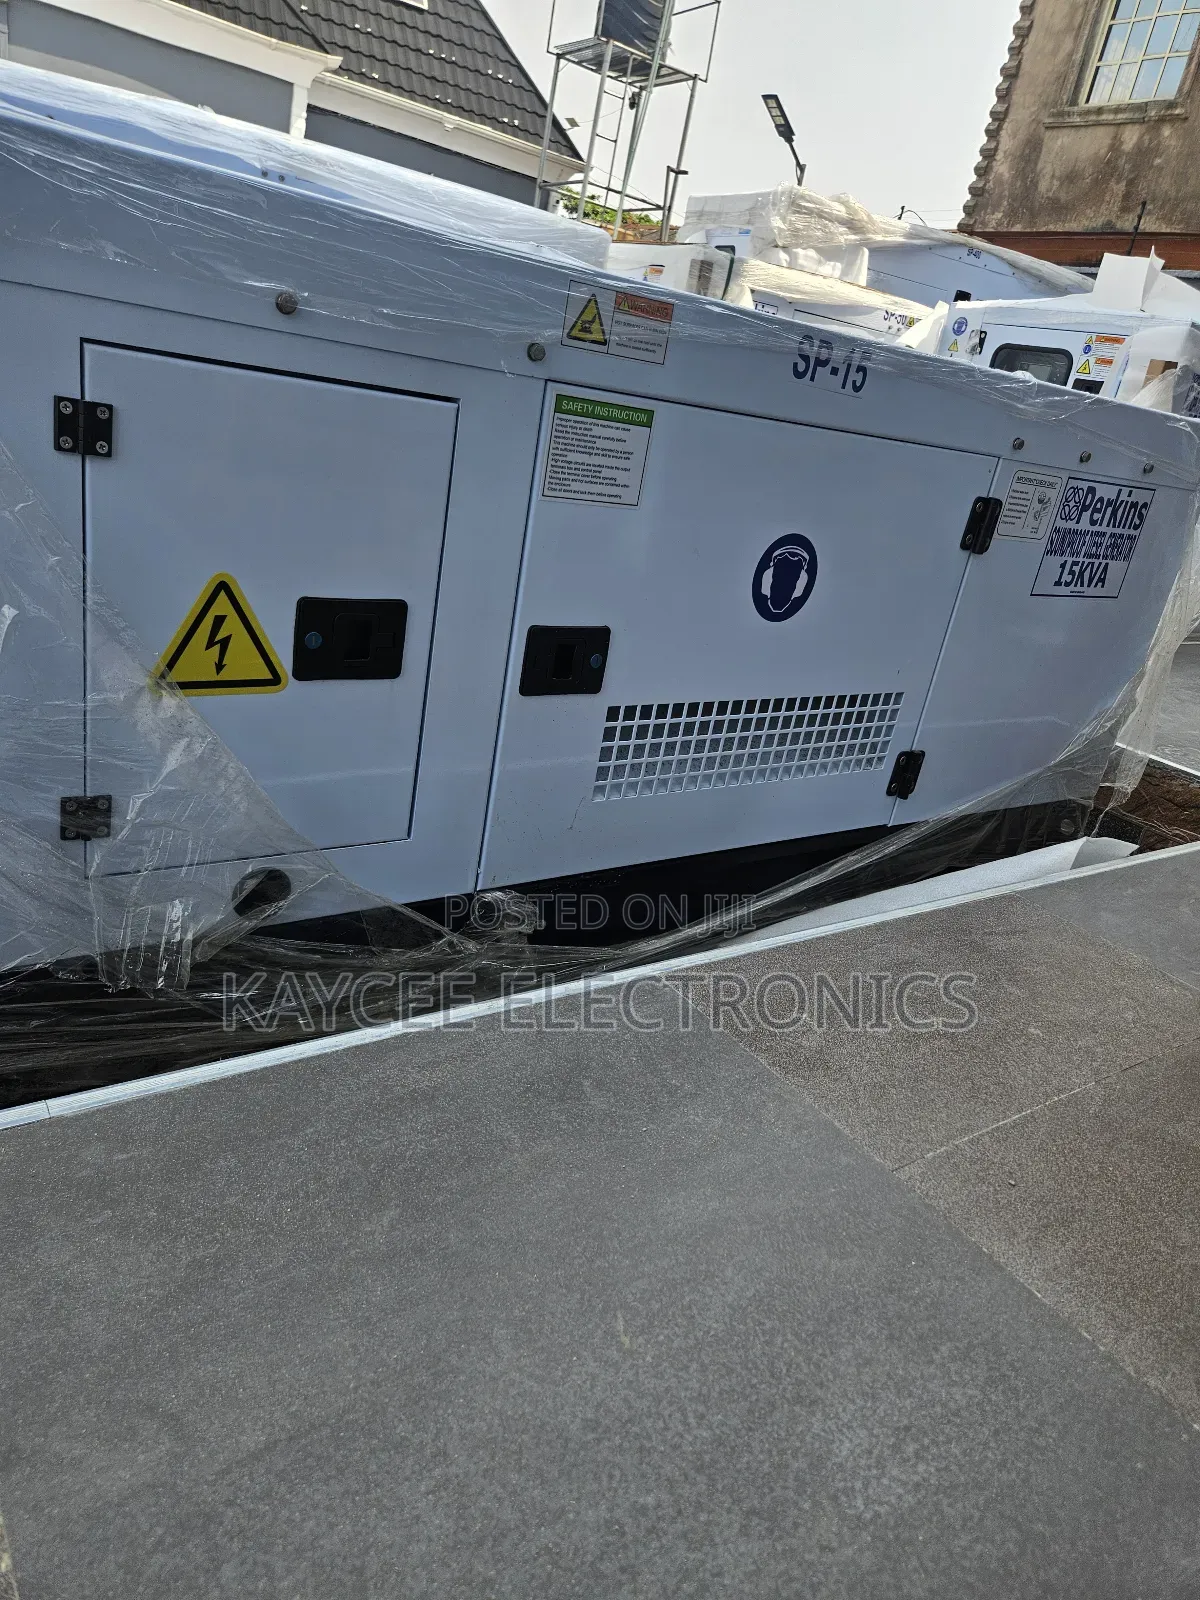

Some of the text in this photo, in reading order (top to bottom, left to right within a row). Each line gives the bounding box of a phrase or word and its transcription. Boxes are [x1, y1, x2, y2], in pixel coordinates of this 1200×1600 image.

[792, 334, 873, 393] SP-15
[561, 400, 648, 423] SAFETY INSTRUCTION
[1075, 486, 1149, 531] Perkins
[1053, 560, 1110, 588] 15KVA
